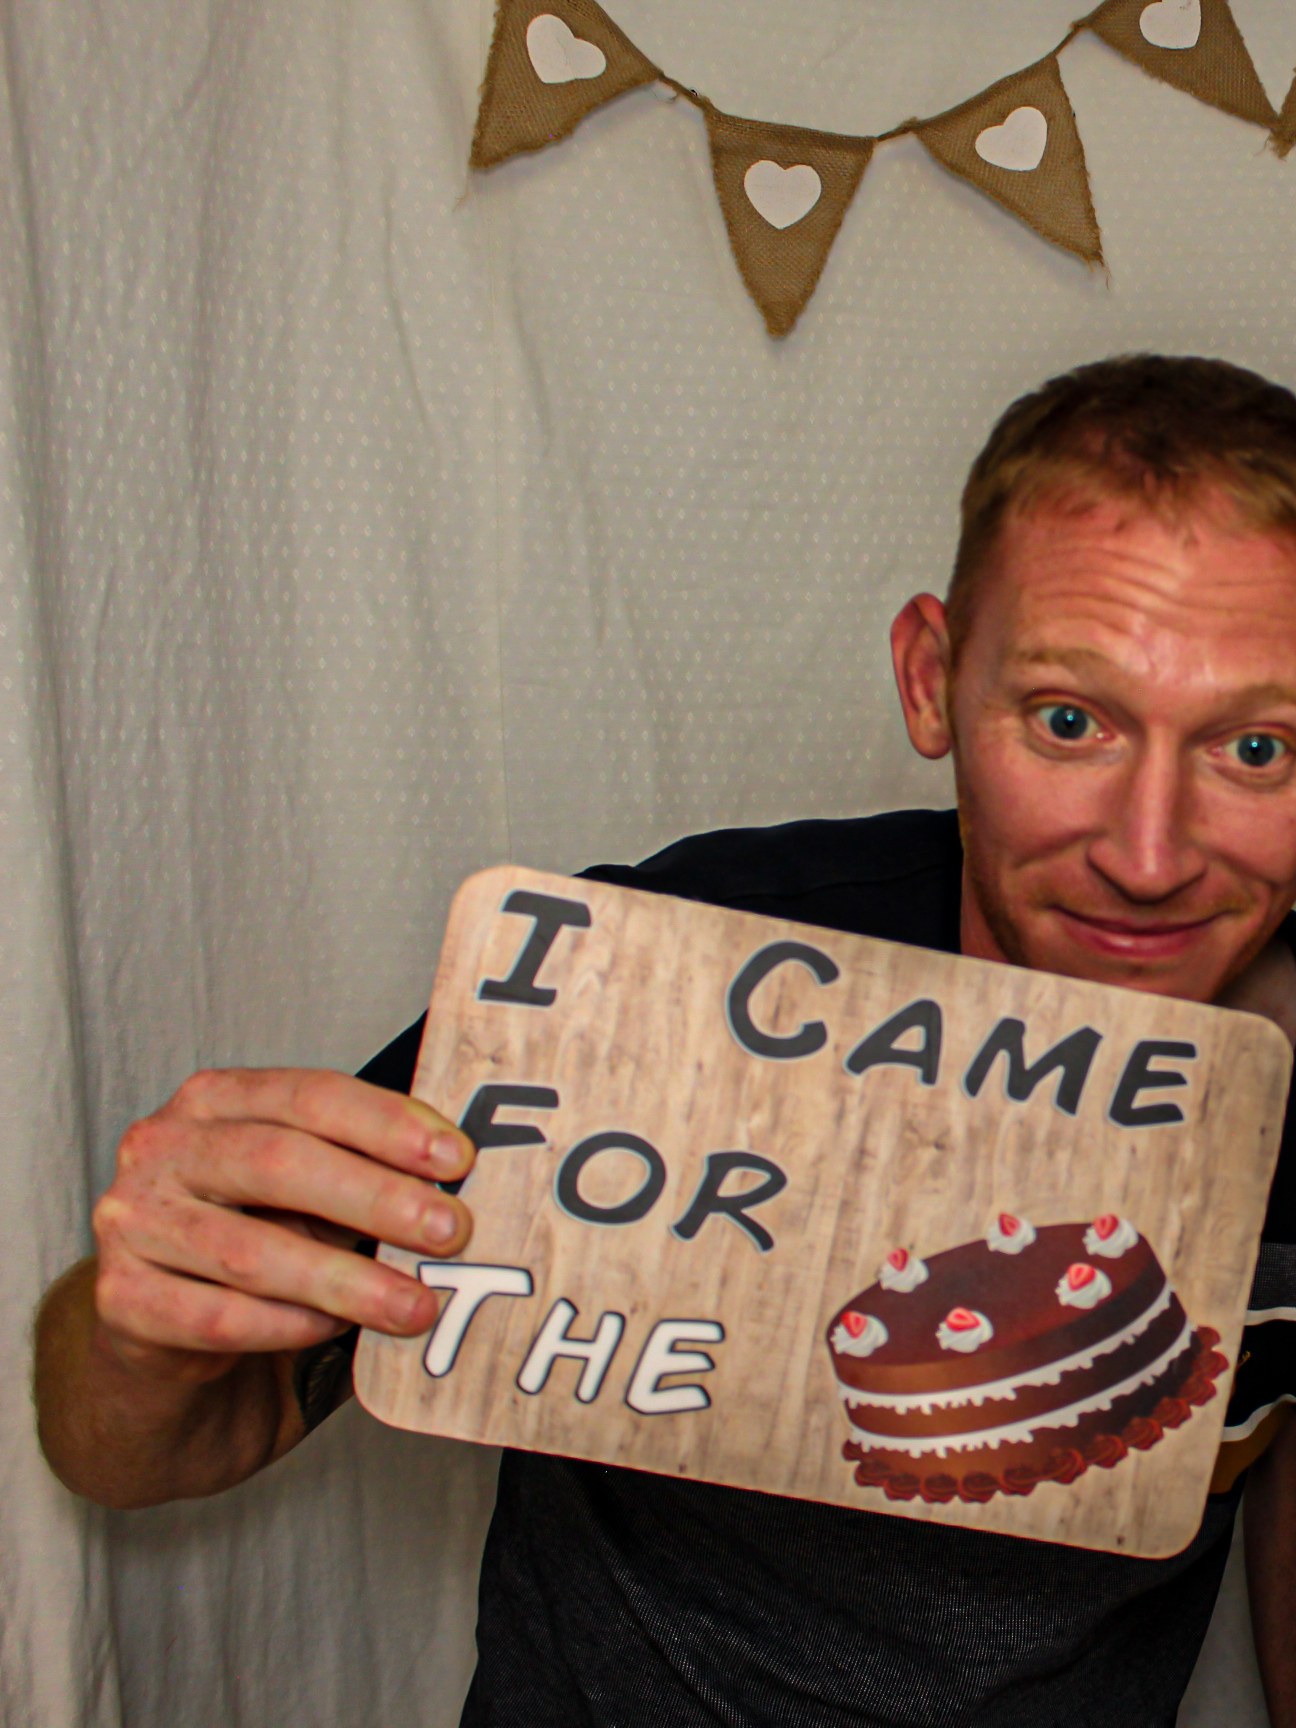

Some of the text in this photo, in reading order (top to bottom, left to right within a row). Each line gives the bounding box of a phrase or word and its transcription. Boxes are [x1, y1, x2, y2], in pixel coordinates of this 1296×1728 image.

[477, 888, 1198, 1129] I CAME
[436, 1084, 788, 1252] FOR
[418, 1261, 725, 1416] THE
